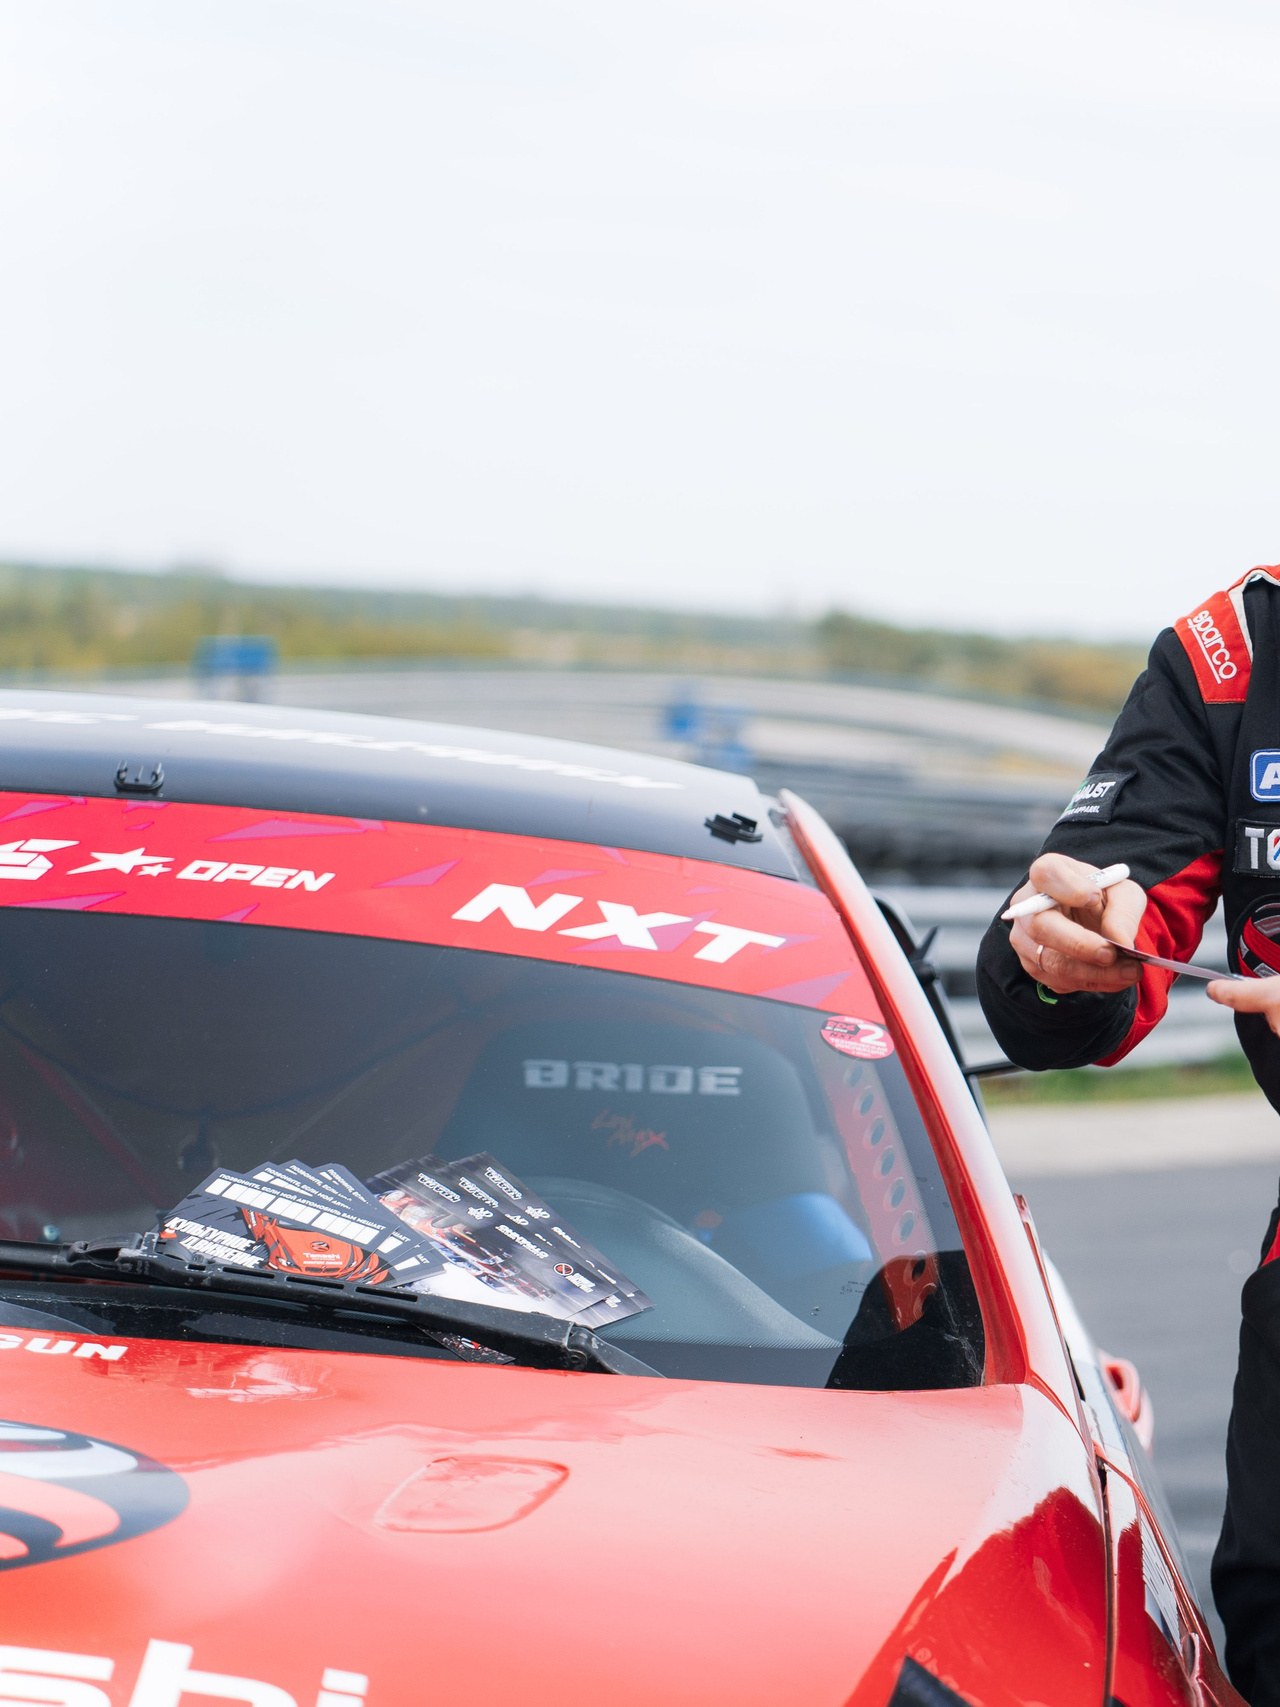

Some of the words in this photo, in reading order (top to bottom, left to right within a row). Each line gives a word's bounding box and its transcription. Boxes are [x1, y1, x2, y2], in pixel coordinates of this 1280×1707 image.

[1188, 609, 1238, 684] sparco
[176, 860, 336, 892] OPEN
[451, 883, 787, 964] NXT
[857, 1024, 887, 1047] 2
[523, 1059, 743, 1095] BRIDE
[164, 1217, 256, 1251] КУЛЬТУРНОЕ
[179, 1235, 264, 1268] ДВИЖЕНИЕ
